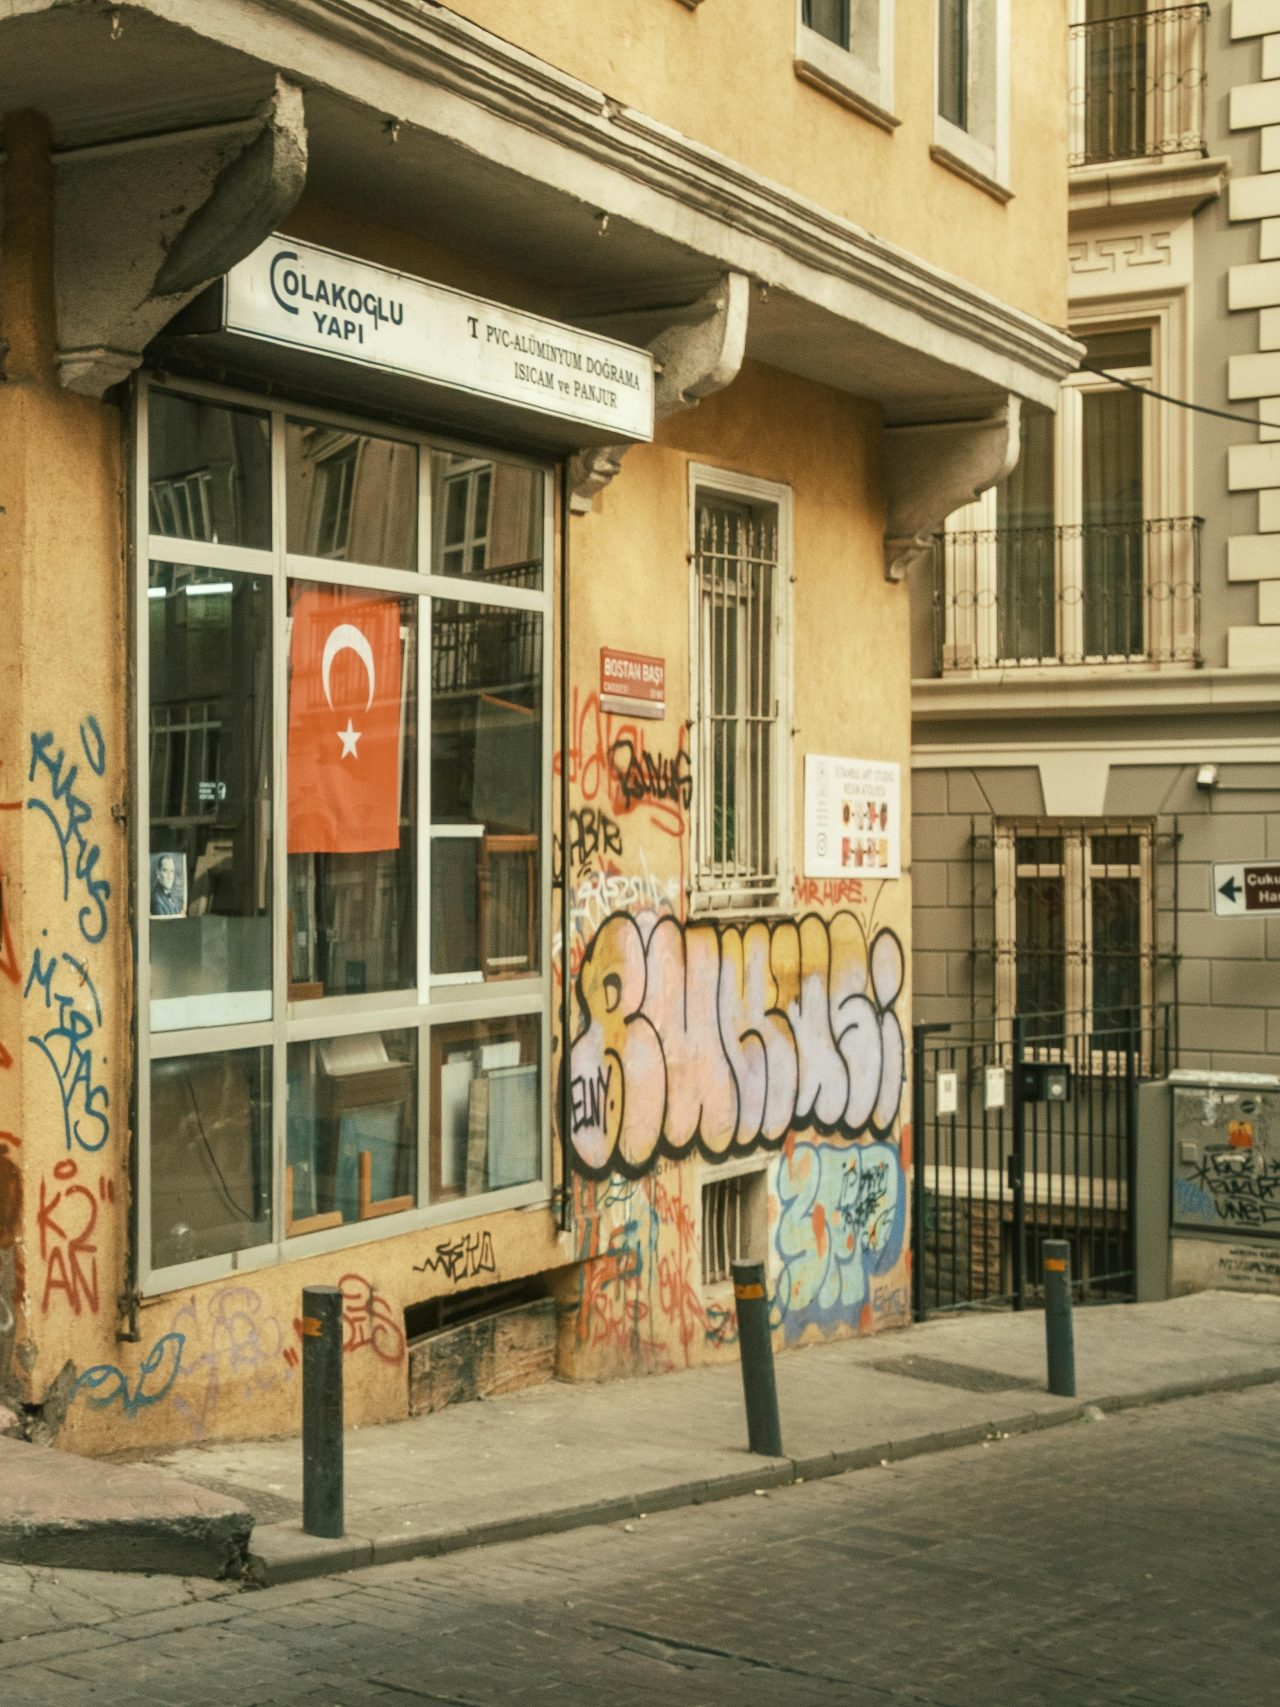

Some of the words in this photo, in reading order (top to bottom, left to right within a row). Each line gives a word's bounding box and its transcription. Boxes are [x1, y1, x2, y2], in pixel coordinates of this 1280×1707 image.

[313, 310, 364, 344] YAPI
[486, 324, 582, 371] PVC-ALÜMİNYUM
[586, 356, 641, 391] DOĞRAMA
[514, 362, 554, 390] ISICAM
[558, 379, 570, 394] ve
[574, 380, 617, 409] PANJUR
[604, 656, 641, 680] BOSTAN
